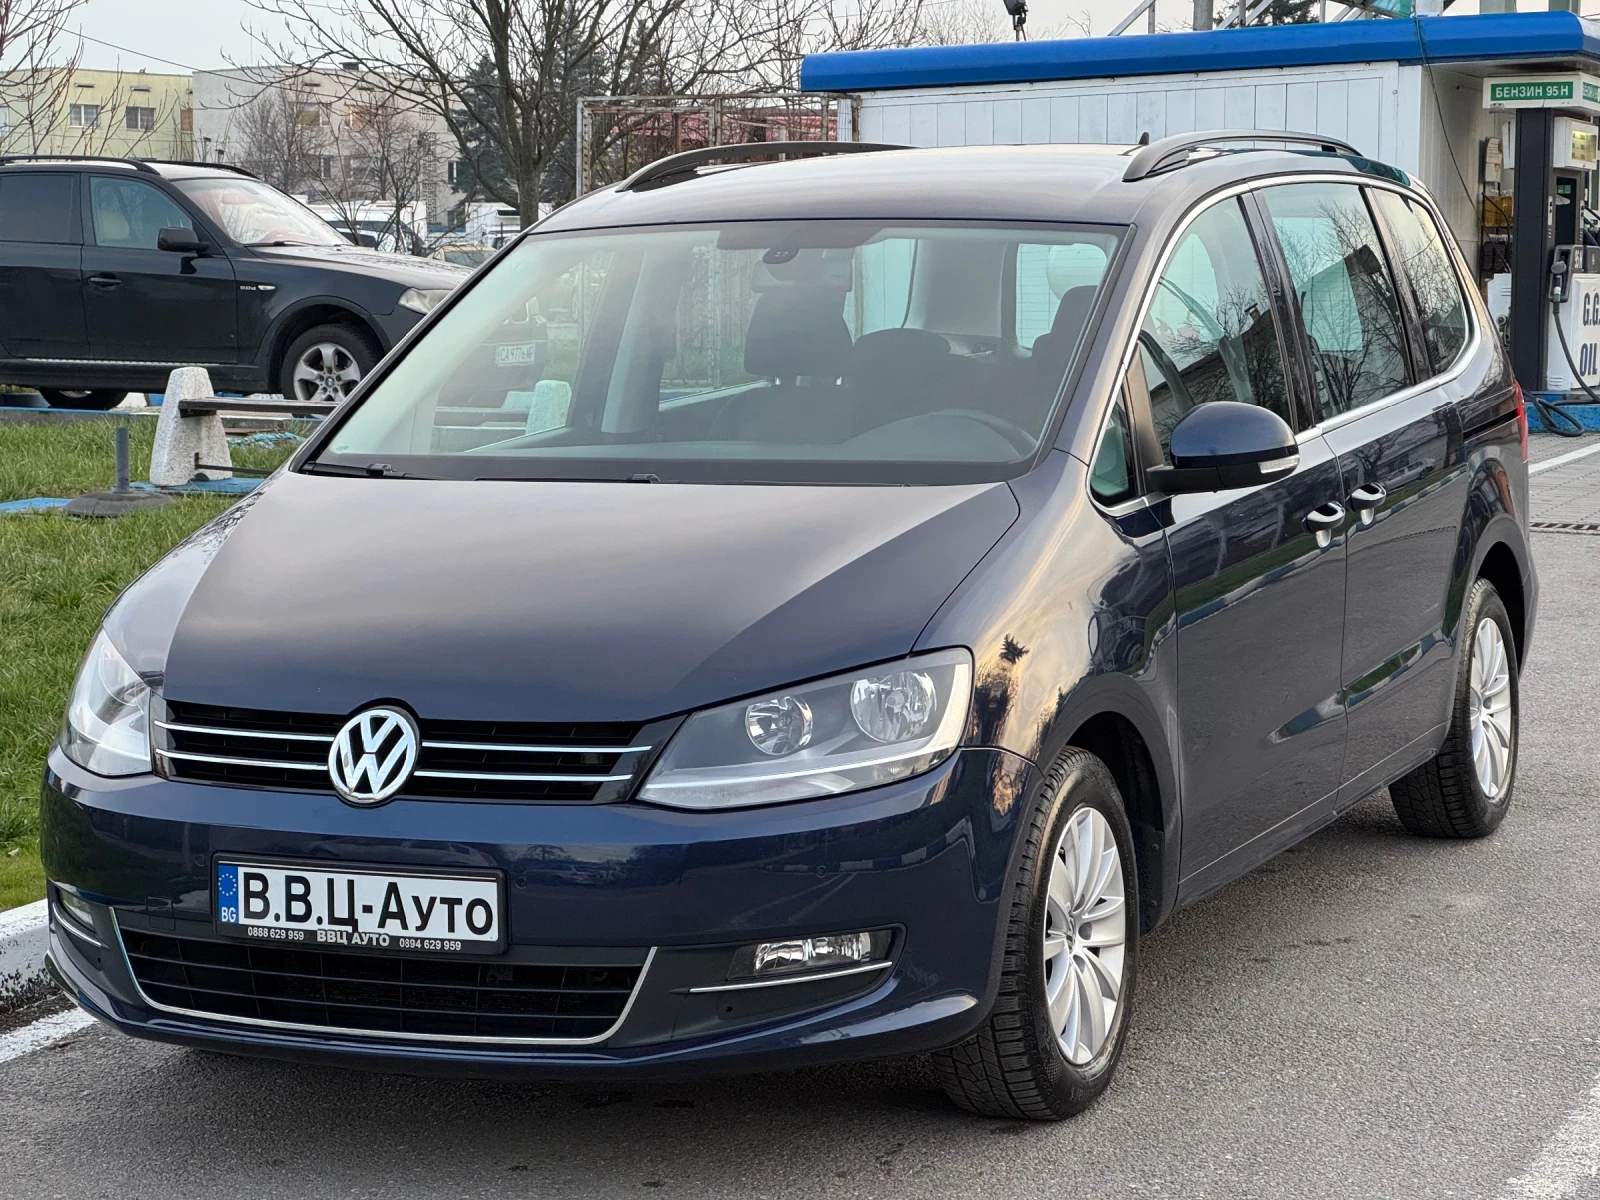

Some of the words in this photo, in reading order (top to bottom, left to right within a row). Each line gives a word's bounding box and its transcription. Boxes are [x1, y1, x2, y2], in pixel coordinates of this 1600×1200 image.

[1495, 85, 1543, 98] БЕНЗИН
[1580, 342, 1598, 377] OIL
[221, 906, 237, 923] BG
[247, 926, 269, 939] 0888
[269, 927, 285, 940] 629
[286, 928, 305, 941] 959
[316, 930, 348, 945] ВВЦ
[351, 932, 390, 947] АУТО
[399, 937, 422, 949] 0894
[423, 939, 442, 950] 629
[443, 940, 462, 951] 959
